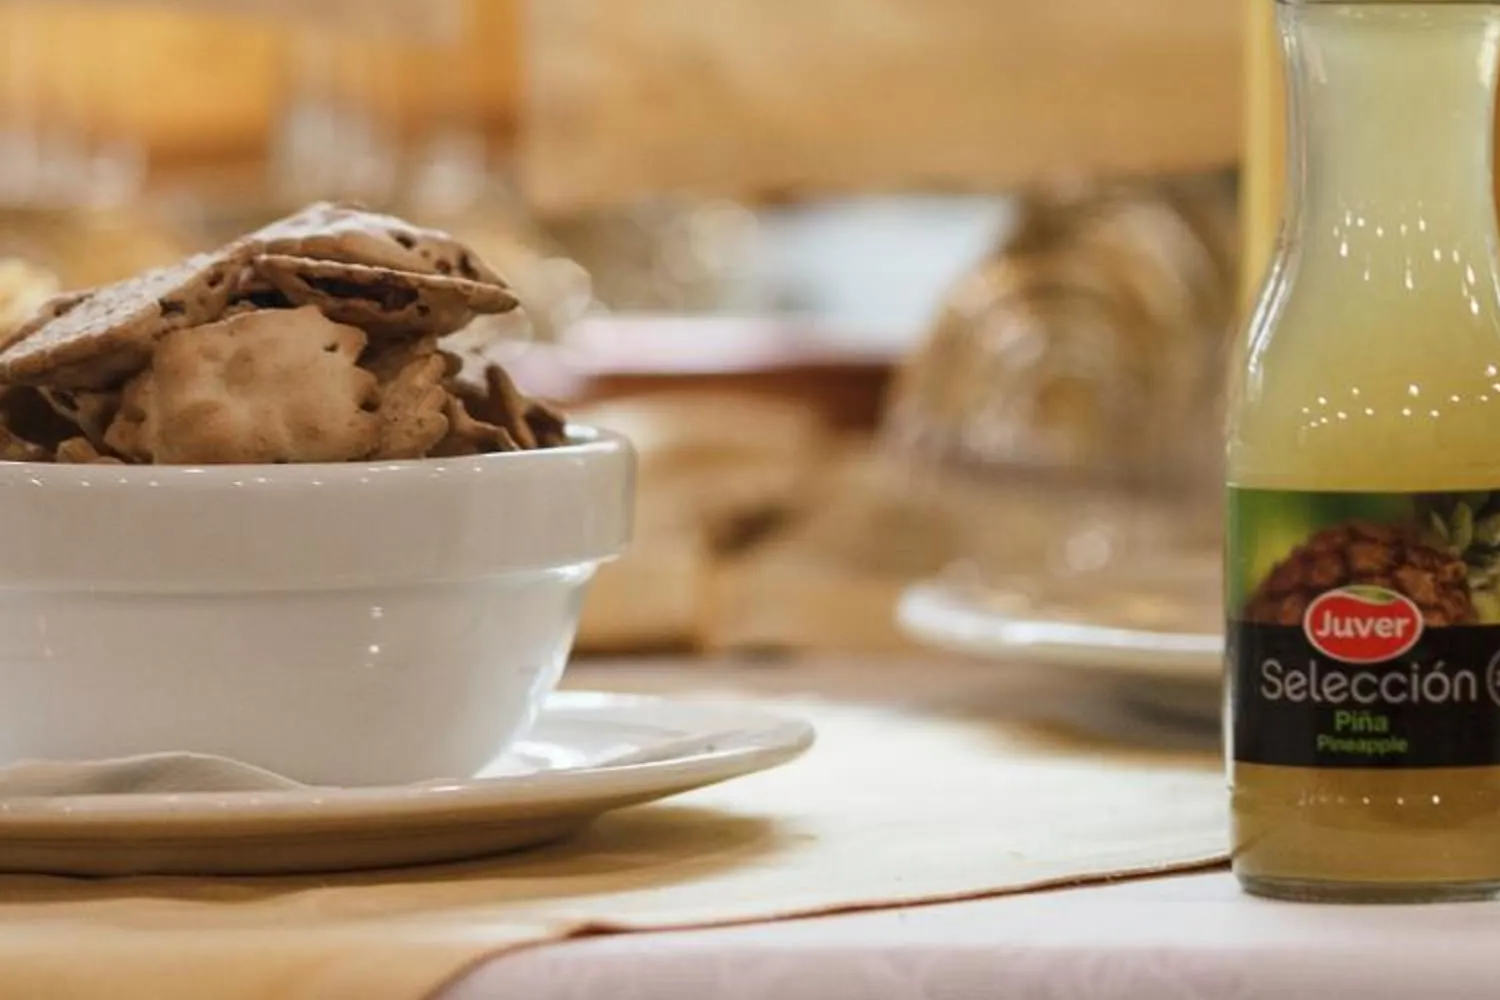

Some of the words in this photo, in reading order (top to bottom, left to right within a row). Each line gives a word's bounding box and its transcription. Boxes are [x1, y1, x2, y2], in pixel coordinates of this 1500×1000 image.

[1315, 610, 1410, 639] Juver
[1261, 659, 1478, 702] Selección
[1334, 710, 1389, 732] Piña
[1316, 734, 1408, 755] Pineapple
